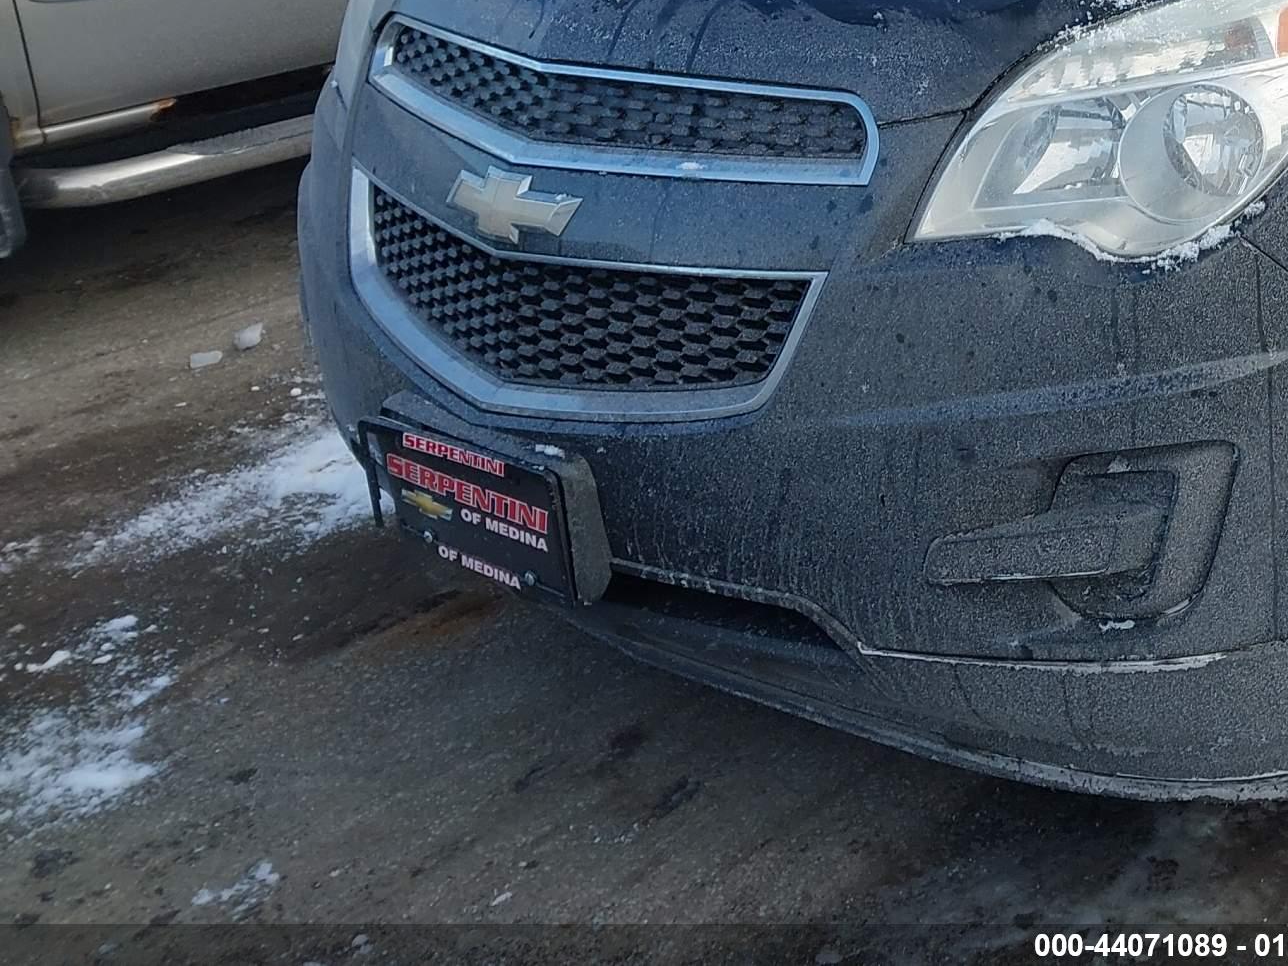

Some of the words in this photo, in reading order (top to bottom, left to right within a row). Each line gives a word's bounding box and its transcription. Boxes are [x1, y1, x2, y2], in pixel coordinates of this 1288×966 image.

[402, 432, 505, 477] SERPENTINI
[386, 453, 549, 534] SERPENTINI
[460, 508, 481, 525] OF
[485, 516, 549, 552] MEDINA
[438, 545, 458, 562] OF
[461, 555, 521, 590] MEDINA
